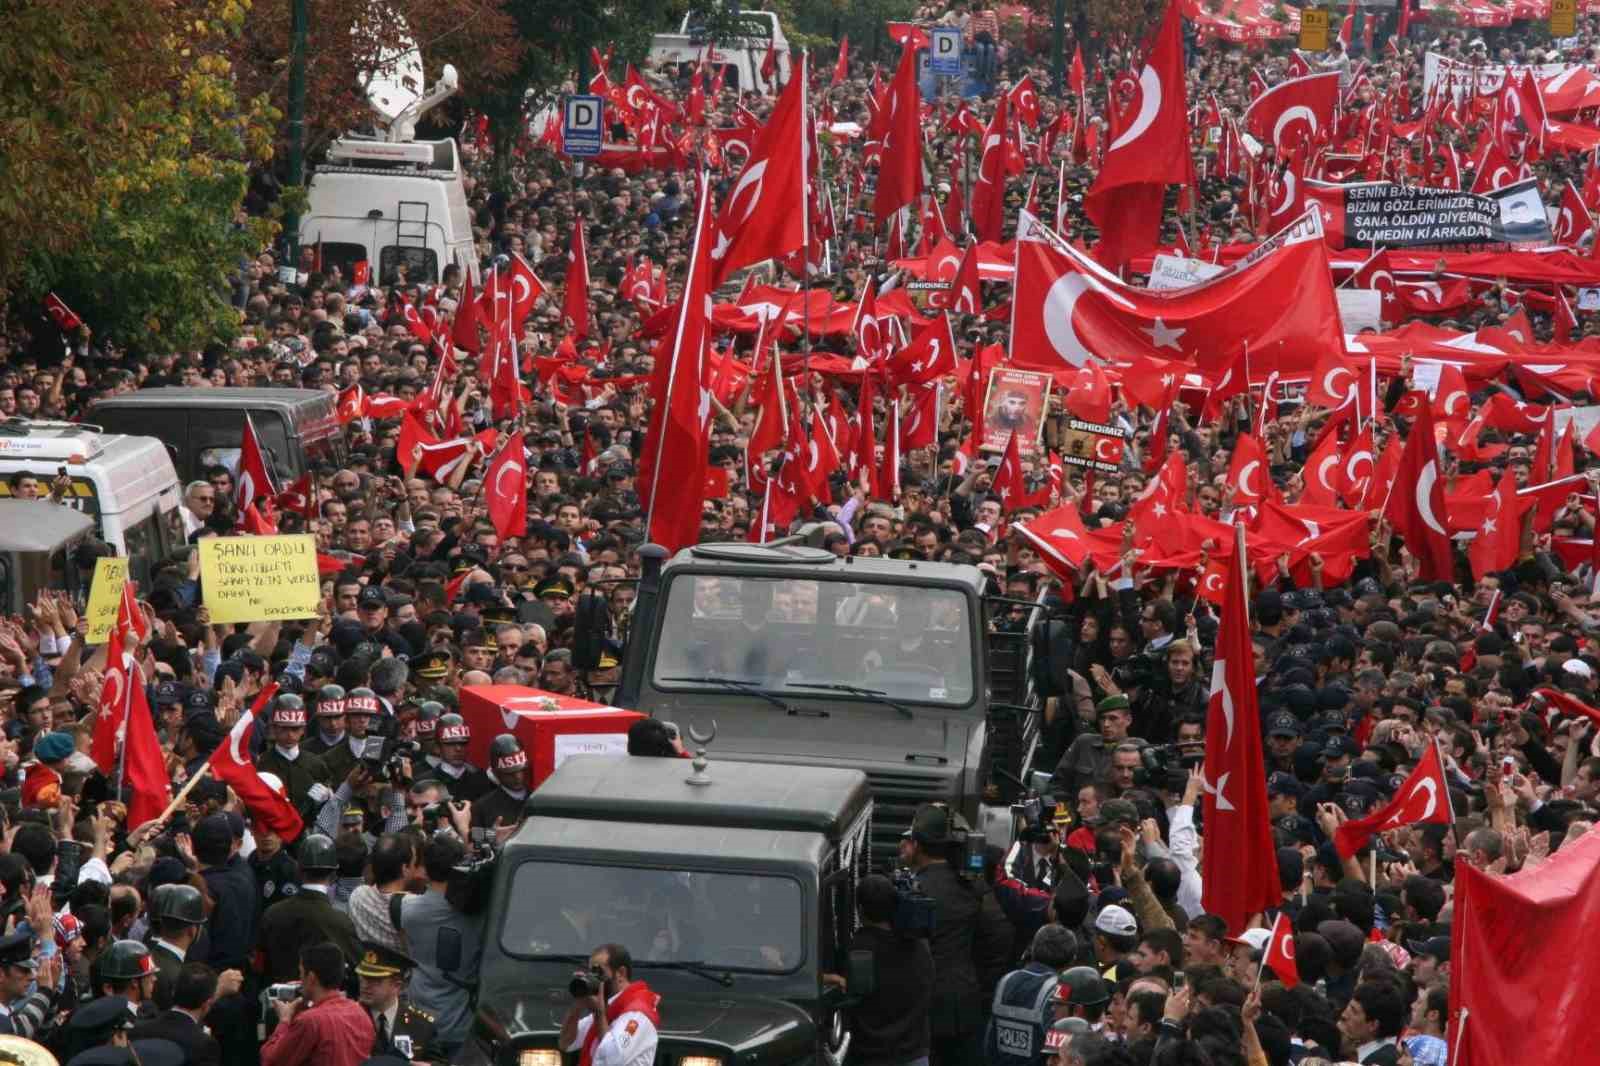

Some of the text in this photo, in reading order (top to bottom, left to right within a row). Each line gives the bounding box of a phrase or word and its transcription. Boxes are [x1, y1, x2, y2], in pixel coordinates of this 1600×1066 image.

[940, 37, 953, 53] D
[576, 104, 593, 126] D
[1347, 200, 1380, 213] BİZİM
[1354, 215, 1388, 227] SANA
[264, 543, 305, 556] ORDU
